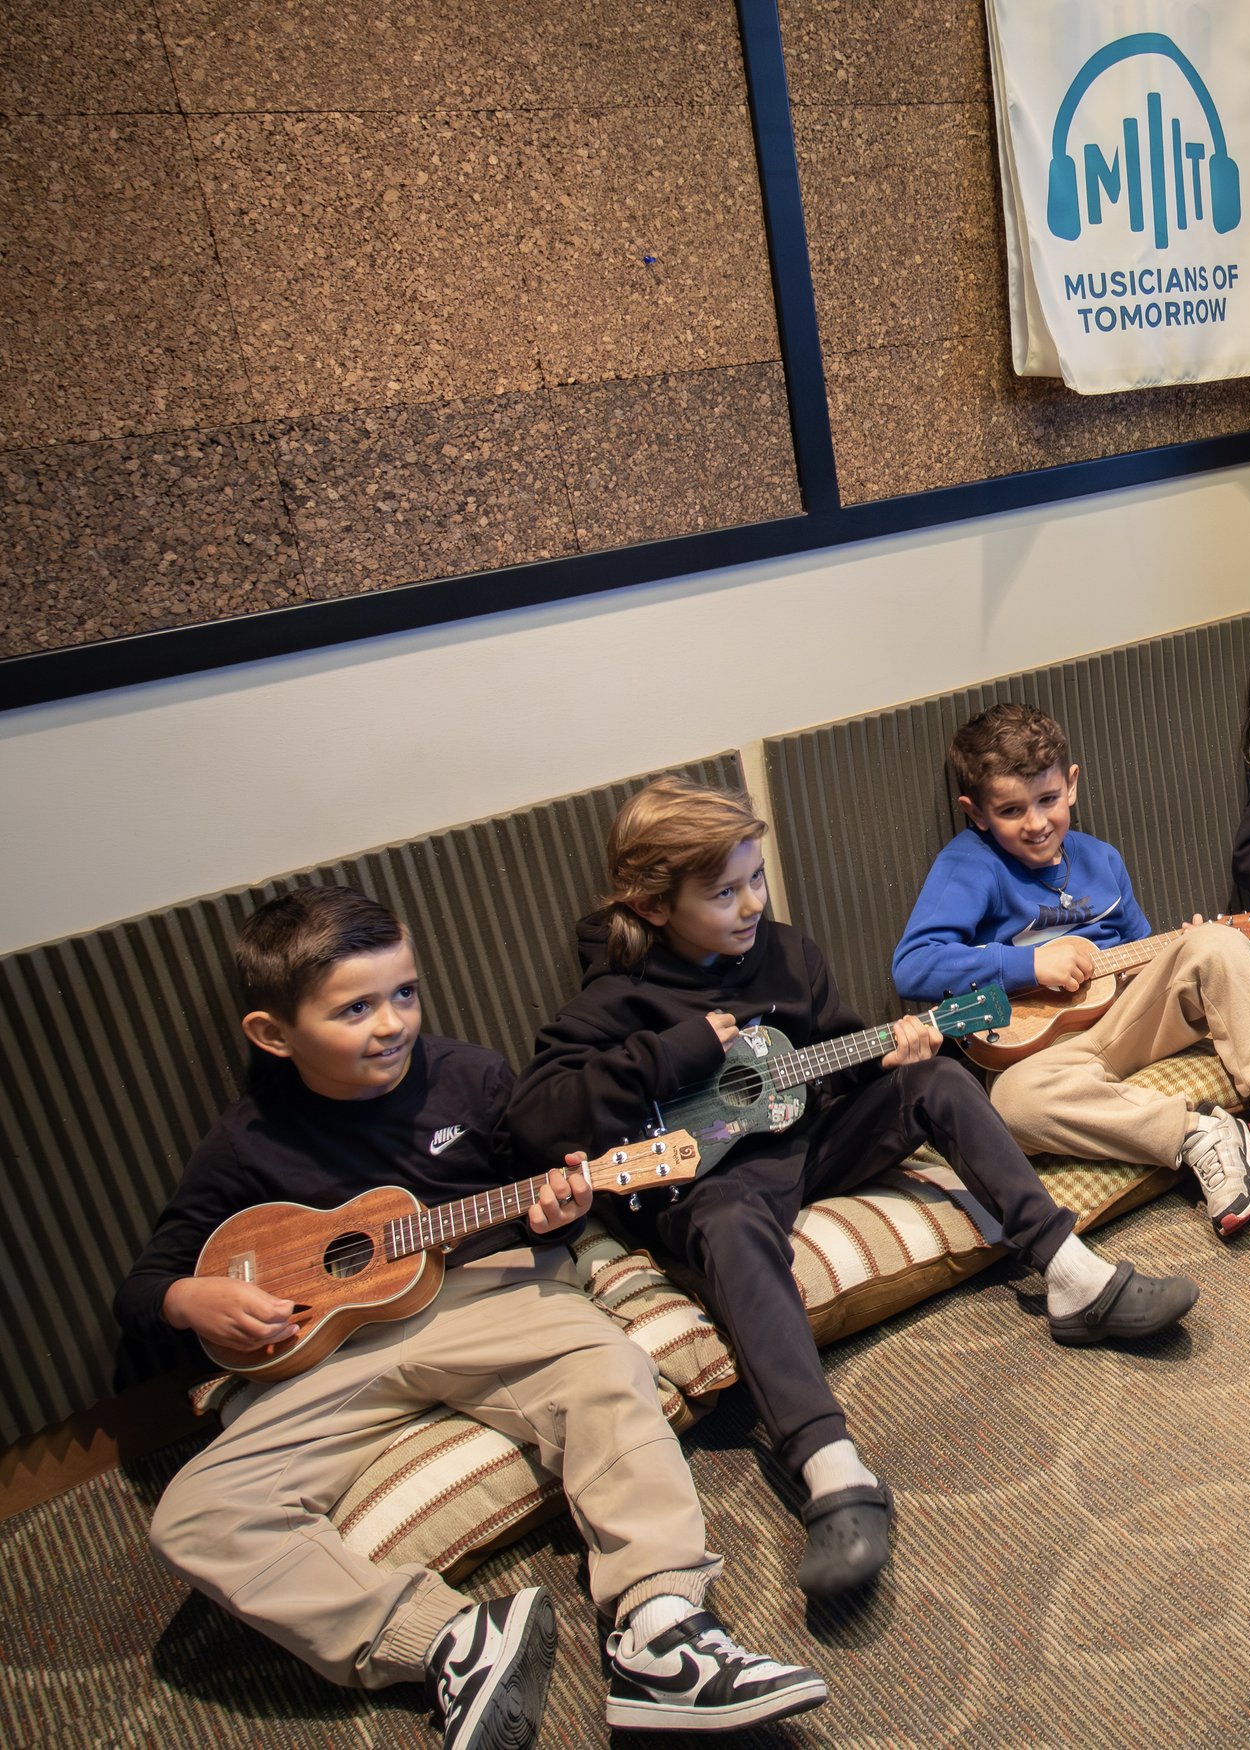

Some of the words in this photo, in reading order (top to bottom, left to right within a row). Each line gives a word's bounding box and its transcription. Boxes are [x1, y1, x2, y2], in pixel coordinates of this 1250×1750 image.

[1064, 266, 1208, 300] MUSICIANS
[1212, 264, 1238, 290] OF
[1077, 297, 1227, 333] TOMORROW
[434, 1124, 461, 1145] NIKE
